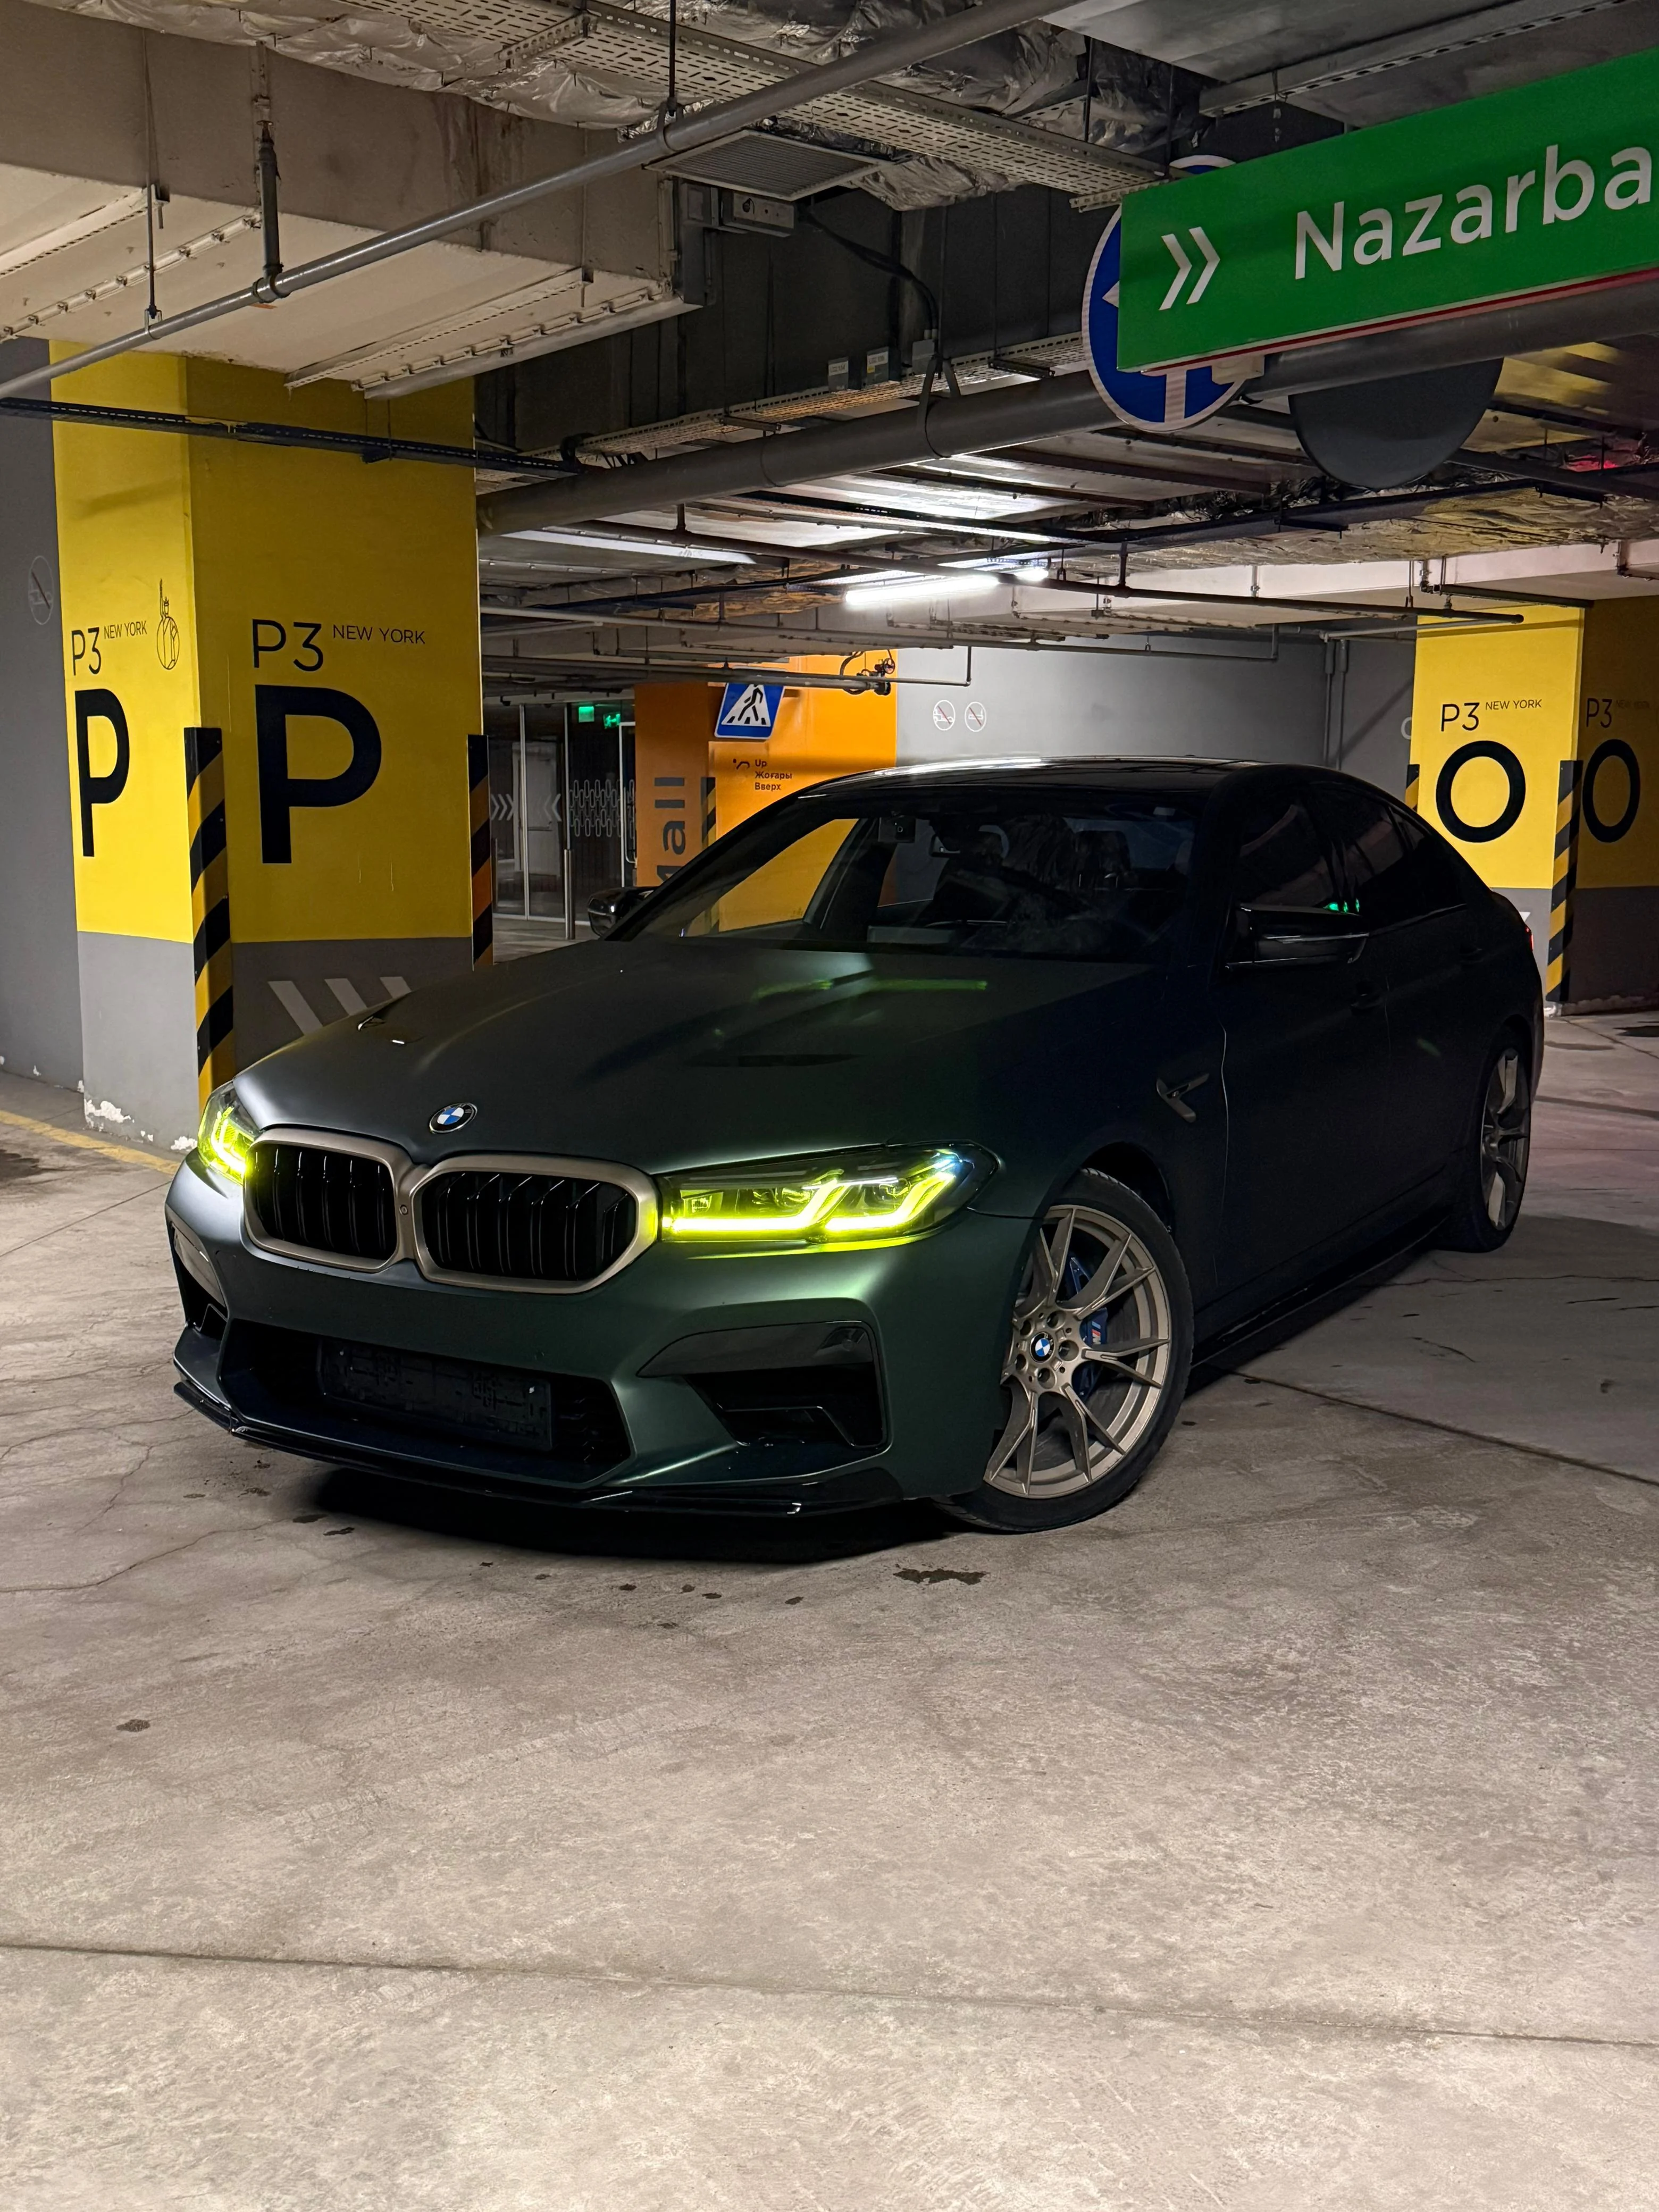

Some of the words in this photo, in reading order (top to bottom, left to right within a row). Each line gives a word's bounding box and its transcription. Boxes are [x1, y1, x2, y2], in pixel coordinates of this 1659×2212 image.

[1295, 144, 1652, 280] Nazarba
[71, 627, 101, 675] P3
[104, 624, 122, 639] NEW
[124, 621, 147, 636] YORK
[252, 619, 323, 672] P3
[333, 624, 373, 641] NEW
[379, 628, 425, 644] YORK
[1441, 702, 1480, 732] P3
[1485, 701, 1510, 710] NEW
[1513, 699, 1542, 709] YORK
[1586, 698, 1613, 728] P3
[74, 688, 130, 857] P
[255, 684, 382, 864] P
[755, 759, 767, 768] Up
[755, 771, 792, 780] Жоғары
[755, 782, 781, 791] Вверх
[1436, 740, 1526, 843] O
[1582, 739, 1640, 842] O
